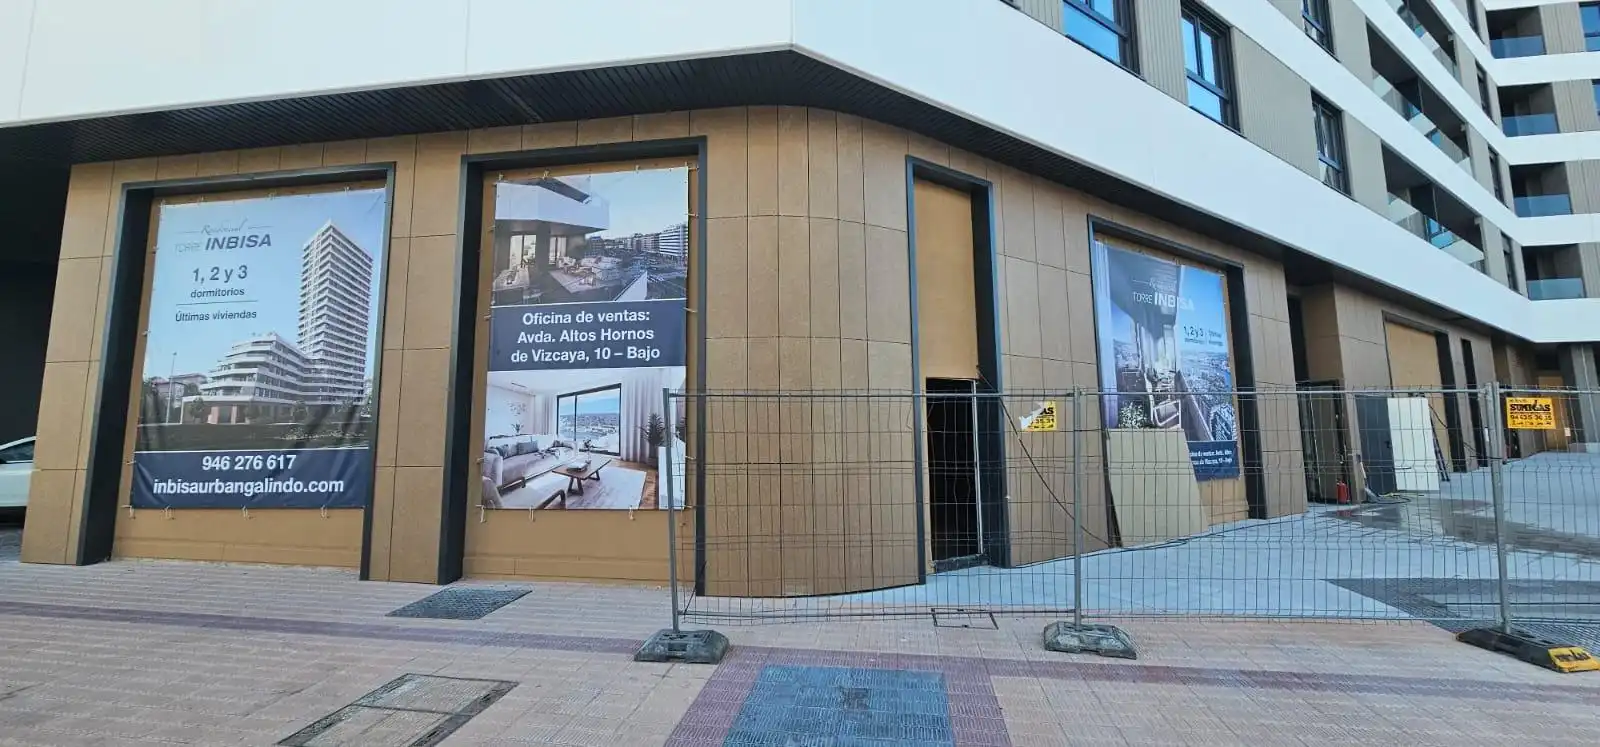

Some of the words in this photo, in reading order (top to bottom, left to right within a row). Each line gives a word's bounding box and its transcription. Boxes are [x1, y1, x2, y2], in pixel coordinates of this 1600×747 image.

[205, 233, 272, 251] INBISA
[192, 267, 205, 284] 1,
[209, 266, 220, 281] 2
[224, 268, 234, 284] y
[237, 264, 248, 280] 3
[190, 287, 245, 299] dormitorios
[1132, 290, 1153, 305] TORRE
[1154, 291, 1196, 311] INBISA
[175, 310, 210, 322] Últimas
[212, 310, 257, 321] viviendas
[522, 312, 572, 325] Oficina
[575, 310, 594, 323] de
[597, 309, 650, 322] ventas:
[517, 331, 556, 344] Avda.
[559, 329, 596, 342] Altos
[600, 328, 655, 341] Hornos
[511, 350, 528, 363] de
[532, 348, 590, 363] Vizcaya,
[594, 347, 611, 360] 10
[626, 346, 661, 361] Bajo
[202, 455, 231, 470] 946
[234, 455, 263, 470] 276
[266, 454, 297, 470] 617
[153, 477, 344, 497] inbisaurbangalindo.com
